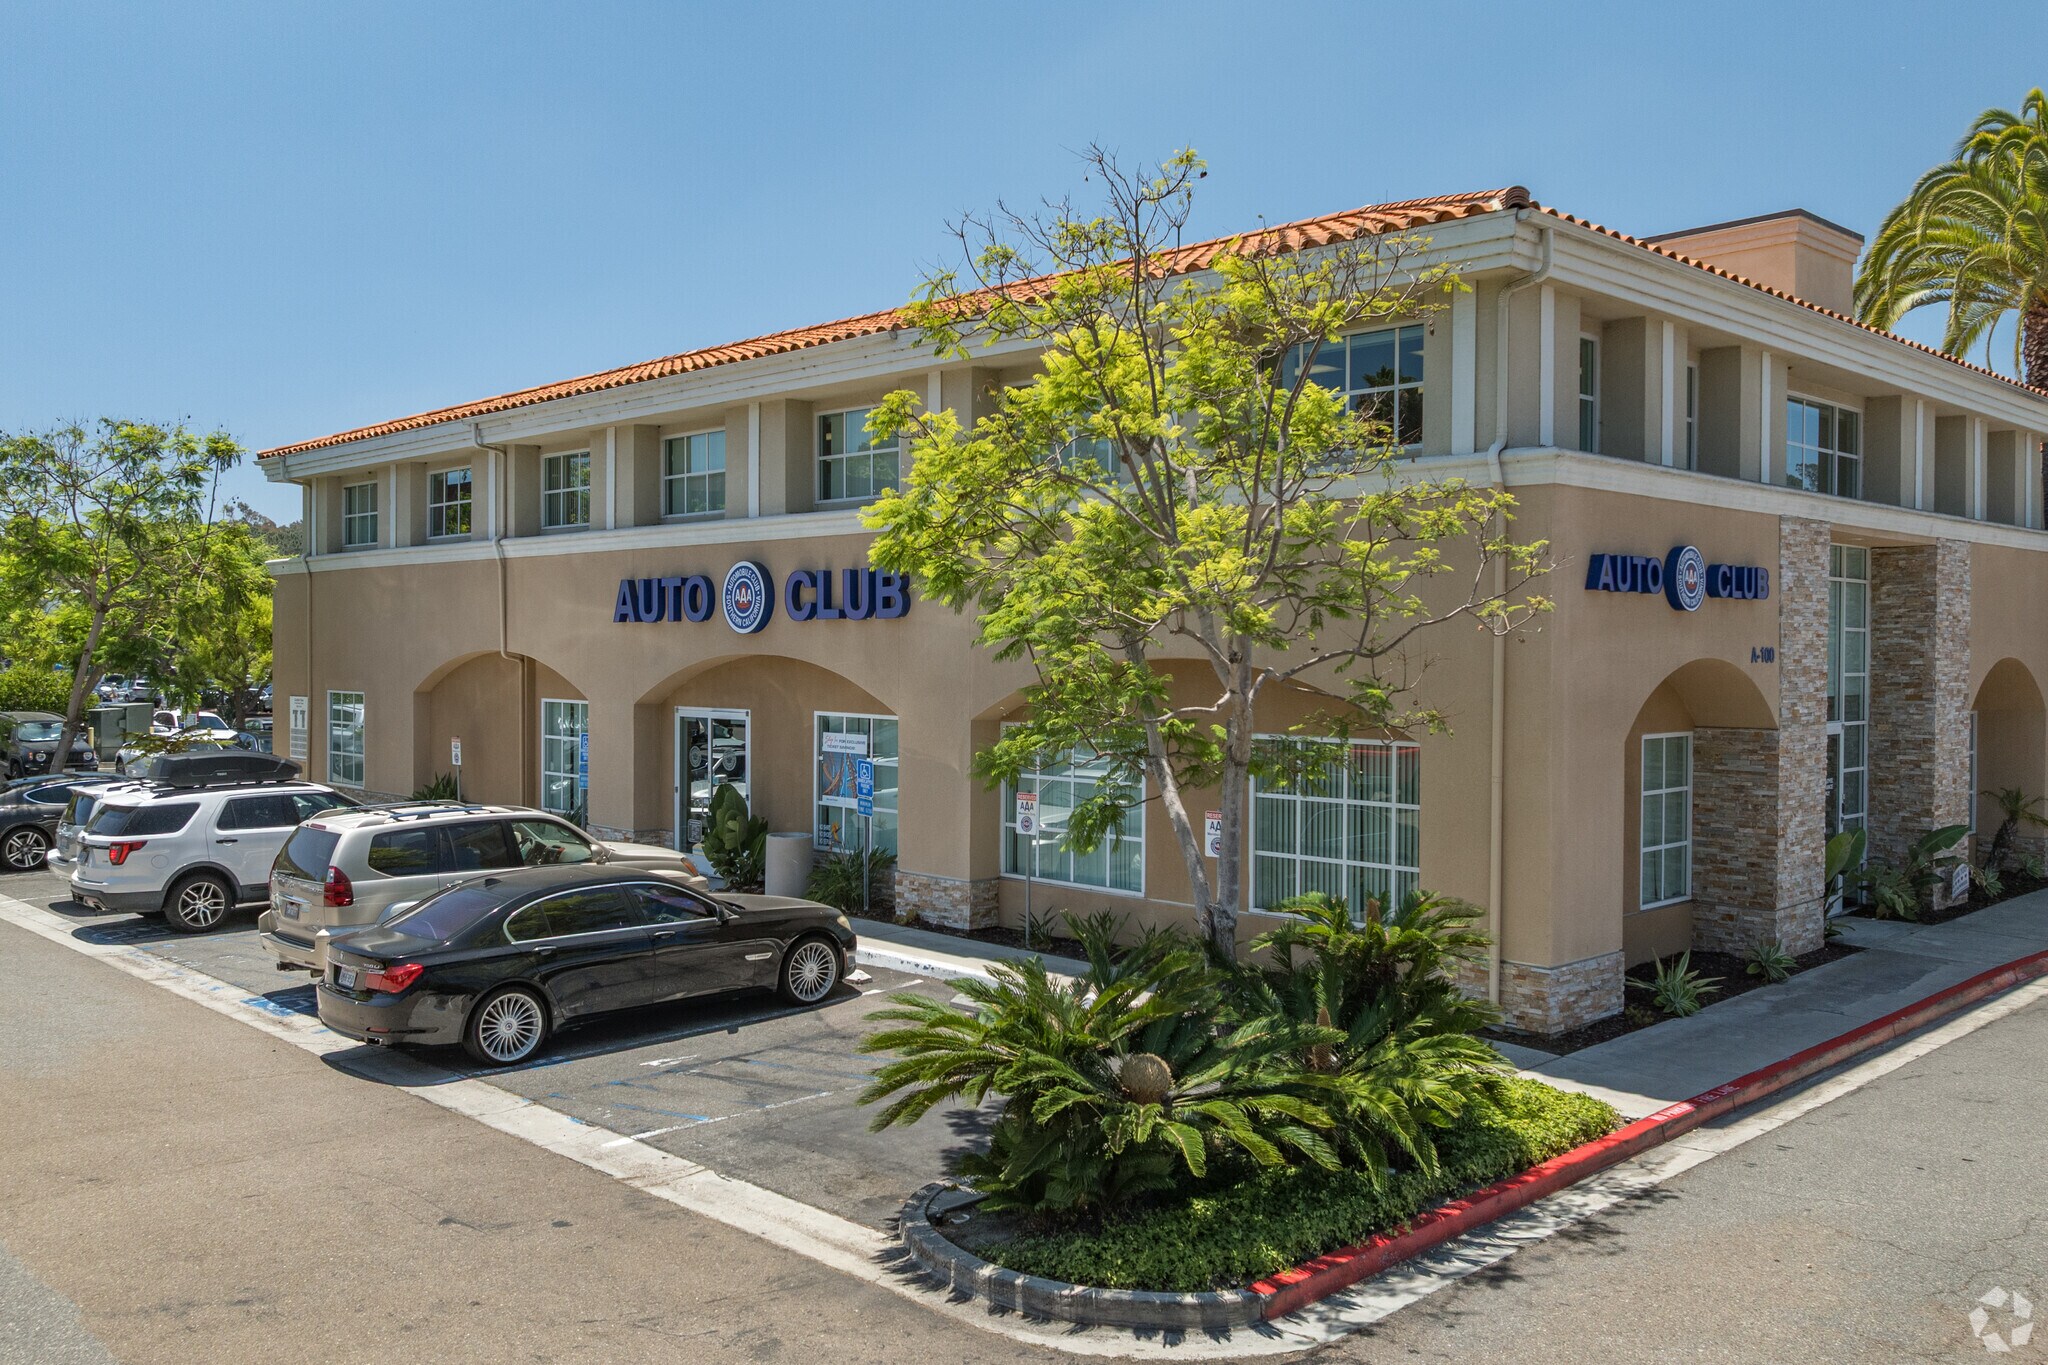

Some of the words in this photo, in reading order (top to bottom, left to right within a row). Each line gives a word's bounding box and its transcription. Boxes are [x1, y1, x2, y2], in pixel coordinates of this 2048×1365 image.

[727, 568, 752, 591] AUTOMOBILE
[750, 574, 761, 592] CLUB
[1596, 553, 1663, 594] AUTO
[1715, 563, 1769, 600] CLUB
[1685, 569, 1698, 585] AAA
[613, 575, 712, 623] AUTO
[785, 567, 906, 621] CLUB
[735, 588, 752, 604] AAA
[726, 595, 742, 627] SOUTHERN
[742, 595, 762, 627] CALIFORNIA
[1750, 646, 1775, 664] A-100
[1020, 801, 1034, 812] AAA
[1206, 812, 1222, 820] RESER
[1209, 821, 1222, 832] AA
